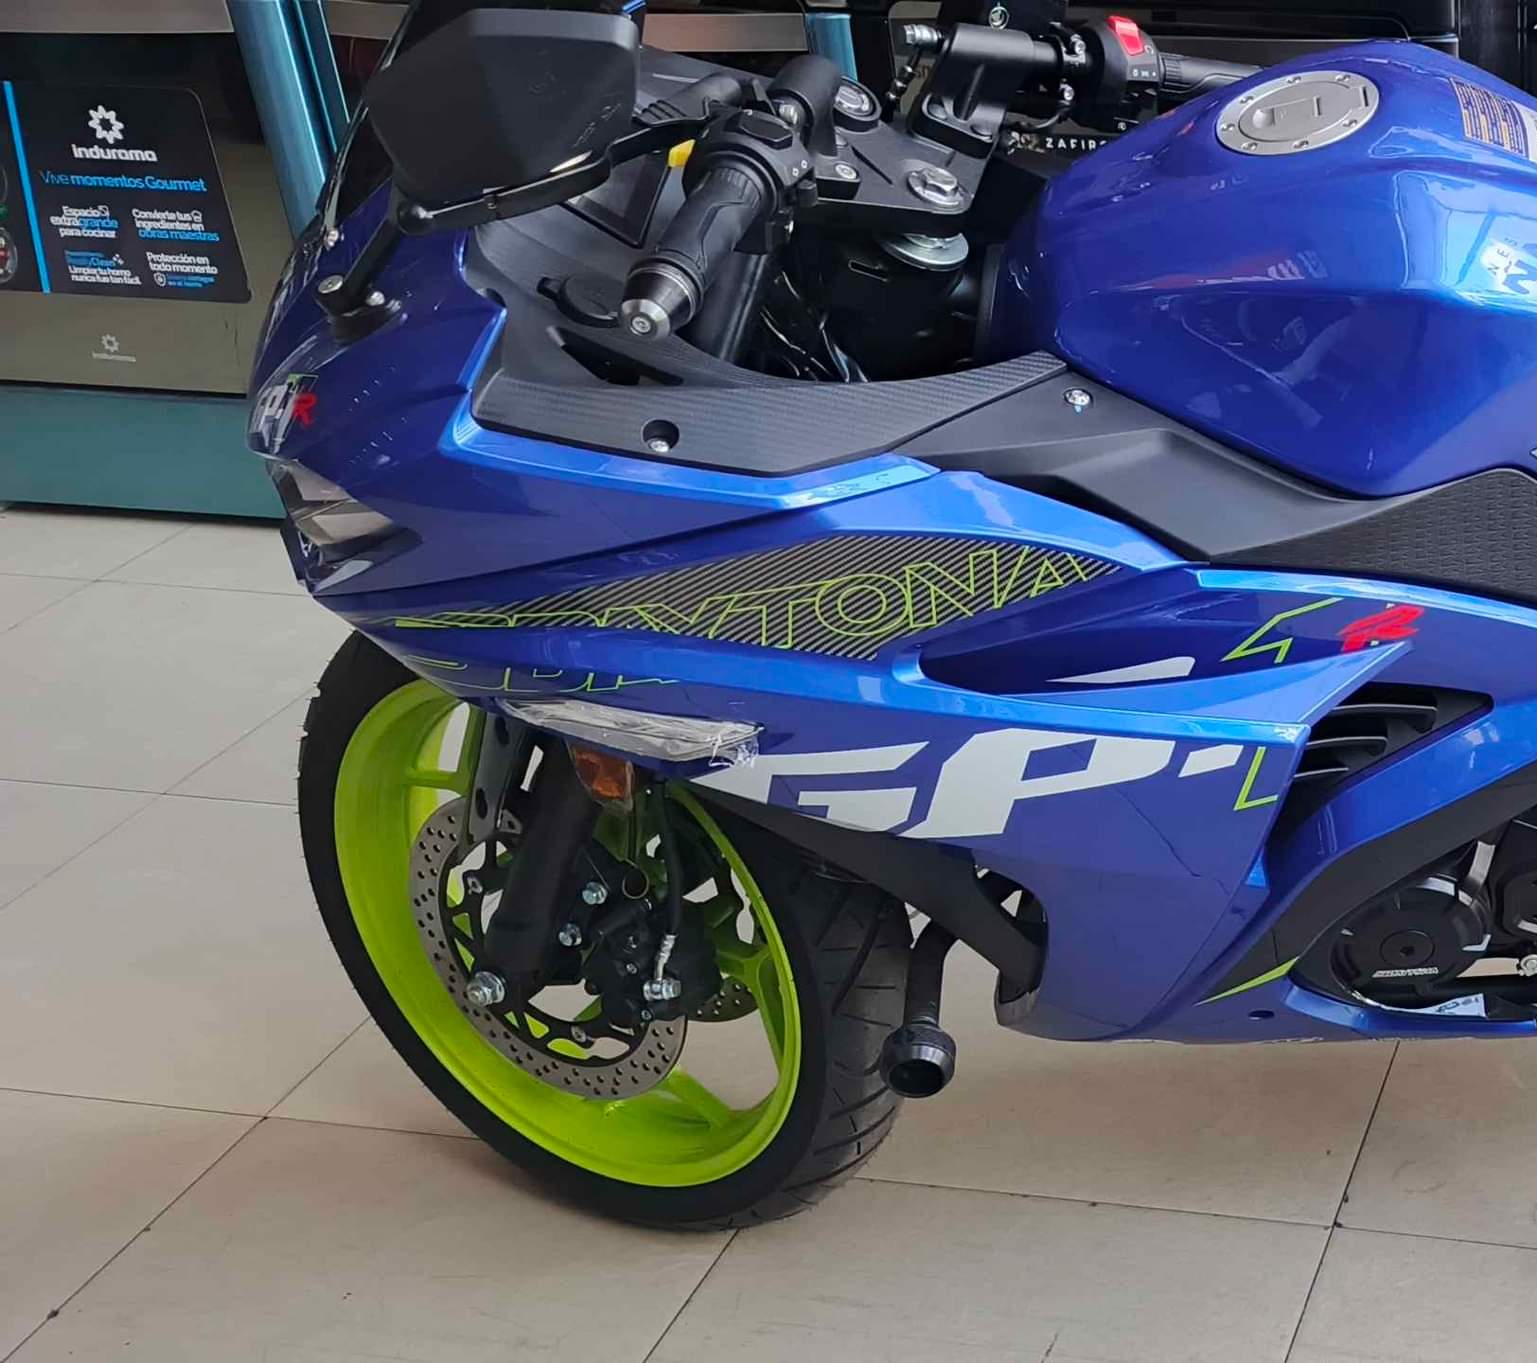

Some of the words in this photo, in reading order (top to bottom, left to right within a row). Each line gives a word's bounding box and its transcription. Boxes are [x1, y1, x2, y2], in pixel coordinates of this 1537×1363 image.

[72, 144, 158, 161] indurama
[40, 171, 69, 185] Vive
[70, 175, 144, 189] momentos
[144, 176, 207, 192] Gourmet
[62, 205, 99, 217] Espacio
[139, 229, 168, 239] obras
[146, 251, 196, 264] Protección
[196, 256, 210, 265] en
[149, 262, 172, 272] todo
[172, 264, 218, 275] momento
